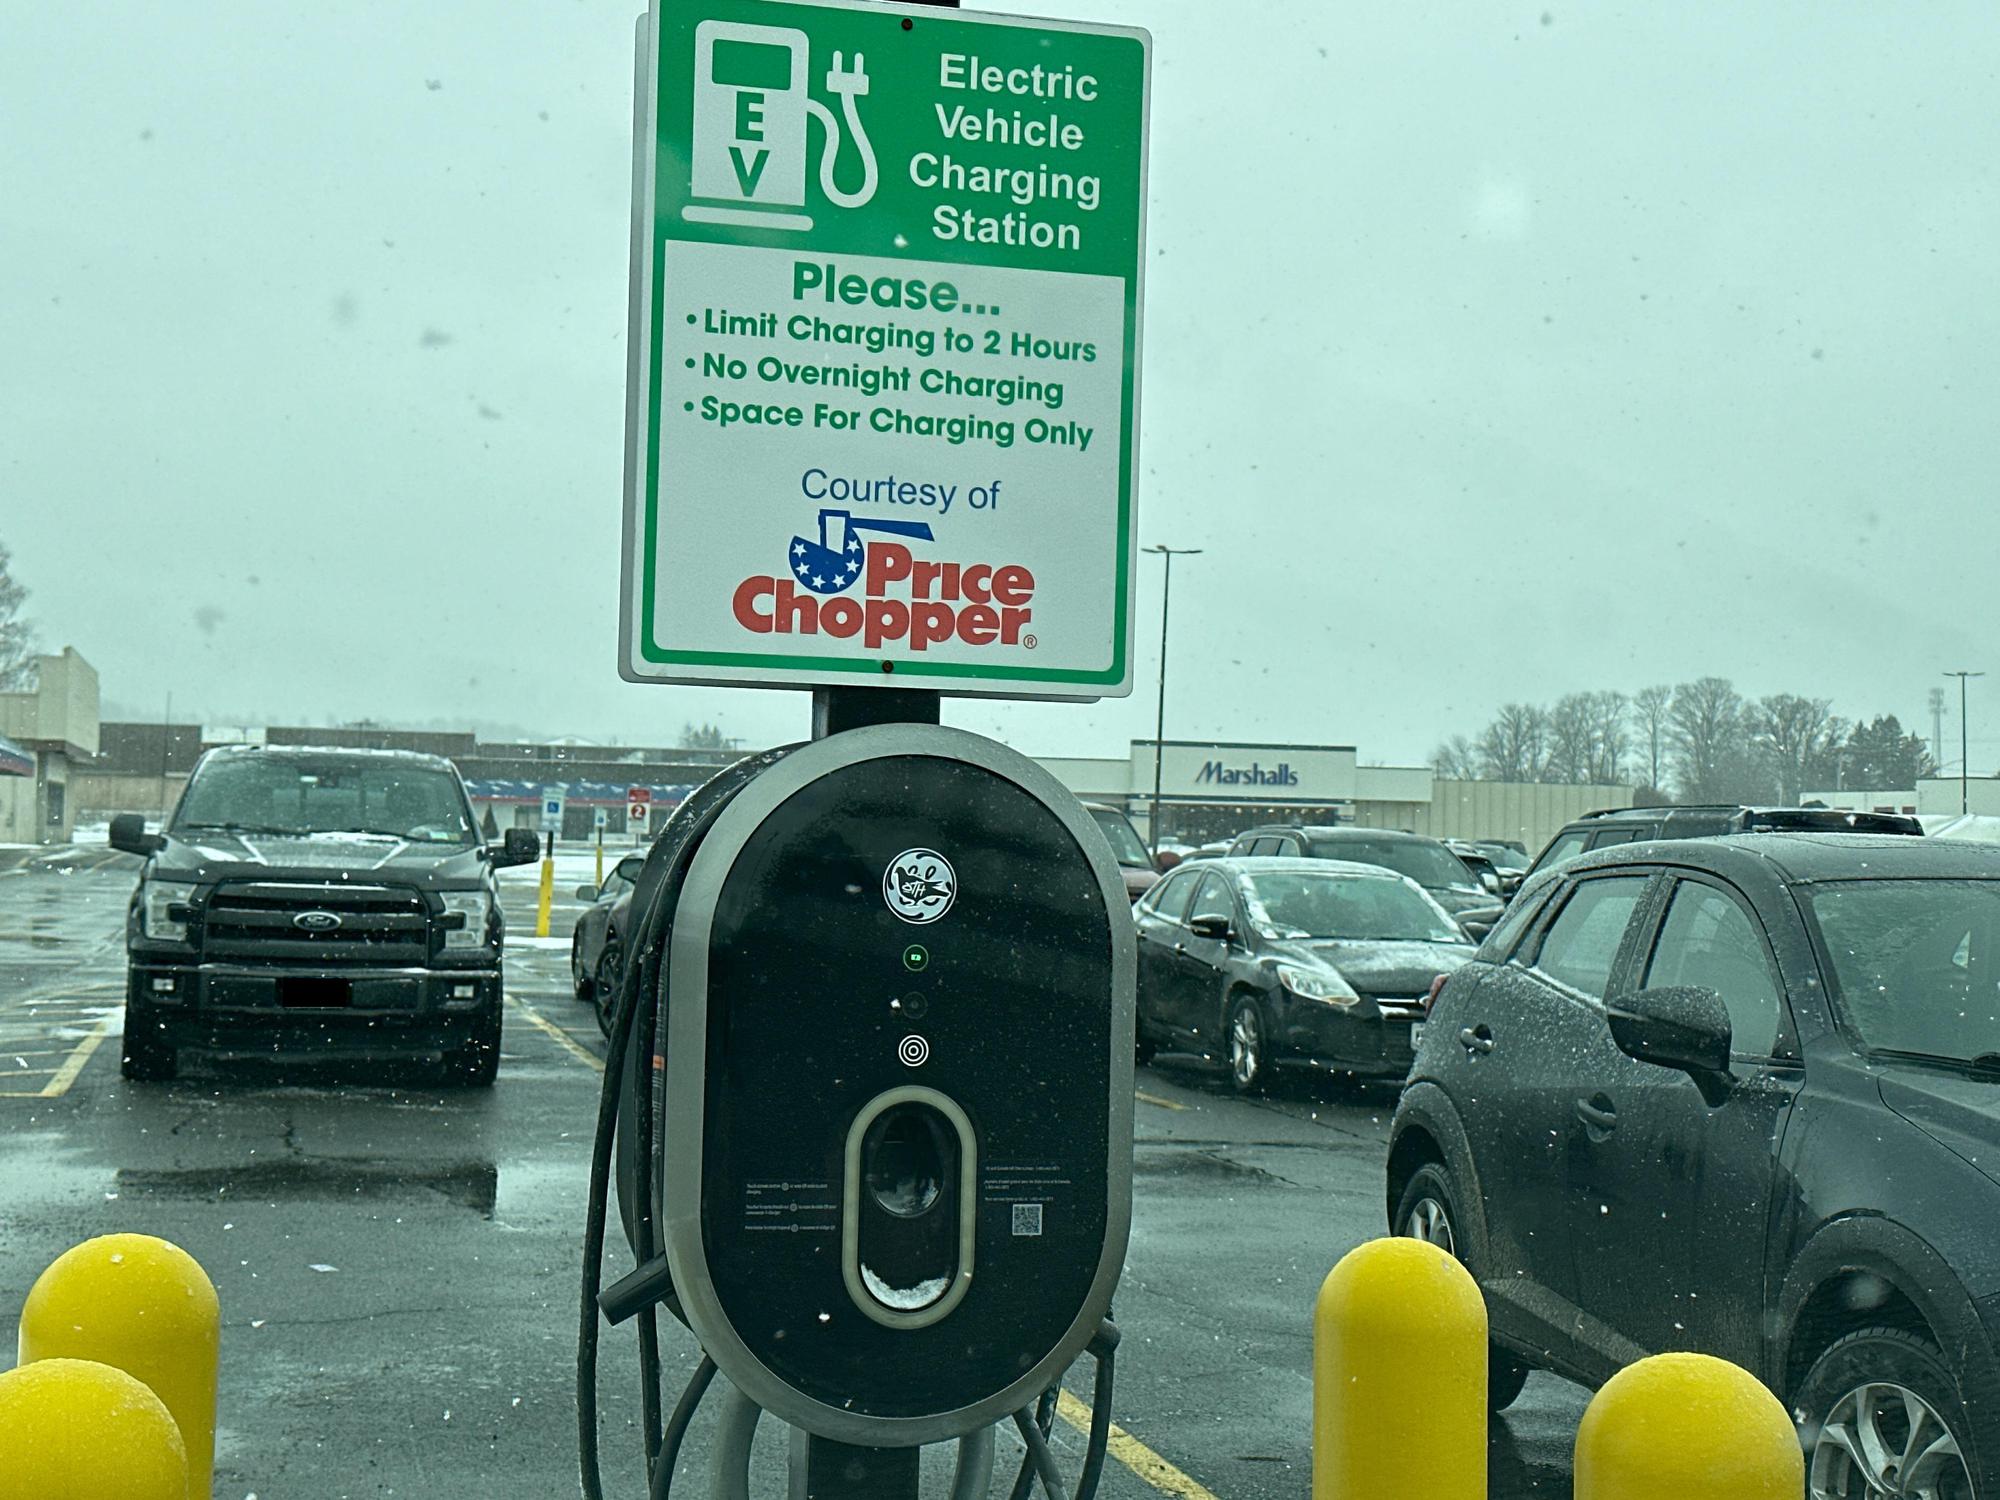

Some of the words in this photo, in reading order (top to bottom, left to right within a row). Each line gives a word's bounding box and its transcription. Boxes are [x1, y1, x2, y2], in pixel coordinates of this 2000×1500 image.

[941, 53, 1097, 101] Electric
[935, 104, 1083, 149] Vehicle
[910, 153, 1099, 210] Charging
[933, 205, 1081, 249] Station
[793, 261, 1000, 315] Please...
[705, 309, 777, 337] Limit
[788, 315, 934, 357] Charging
[944, 328, 973, 352] to
[984, 330, 1000, 354] 2
[1012, 333, 1096, 362] Hours
[704, 353, 747, 379] No
[758, 357, 911, 396] Overnight
[920, 369, 1063, 409] Charging
[701, 396, 803, 427] Space
[815, 404, 860, 430] For
[870, 408, 1014, 448] Charging
[1025, 419, 1093, 451] Only
[802, 469, 957, 514] Courtesy
[969, 481, 1001, 509] of
[866, 542, 1034, 606] Price
[733, 575, 1031, 651] Chopper
[1196, 761, 1298, 786] Marshalls
